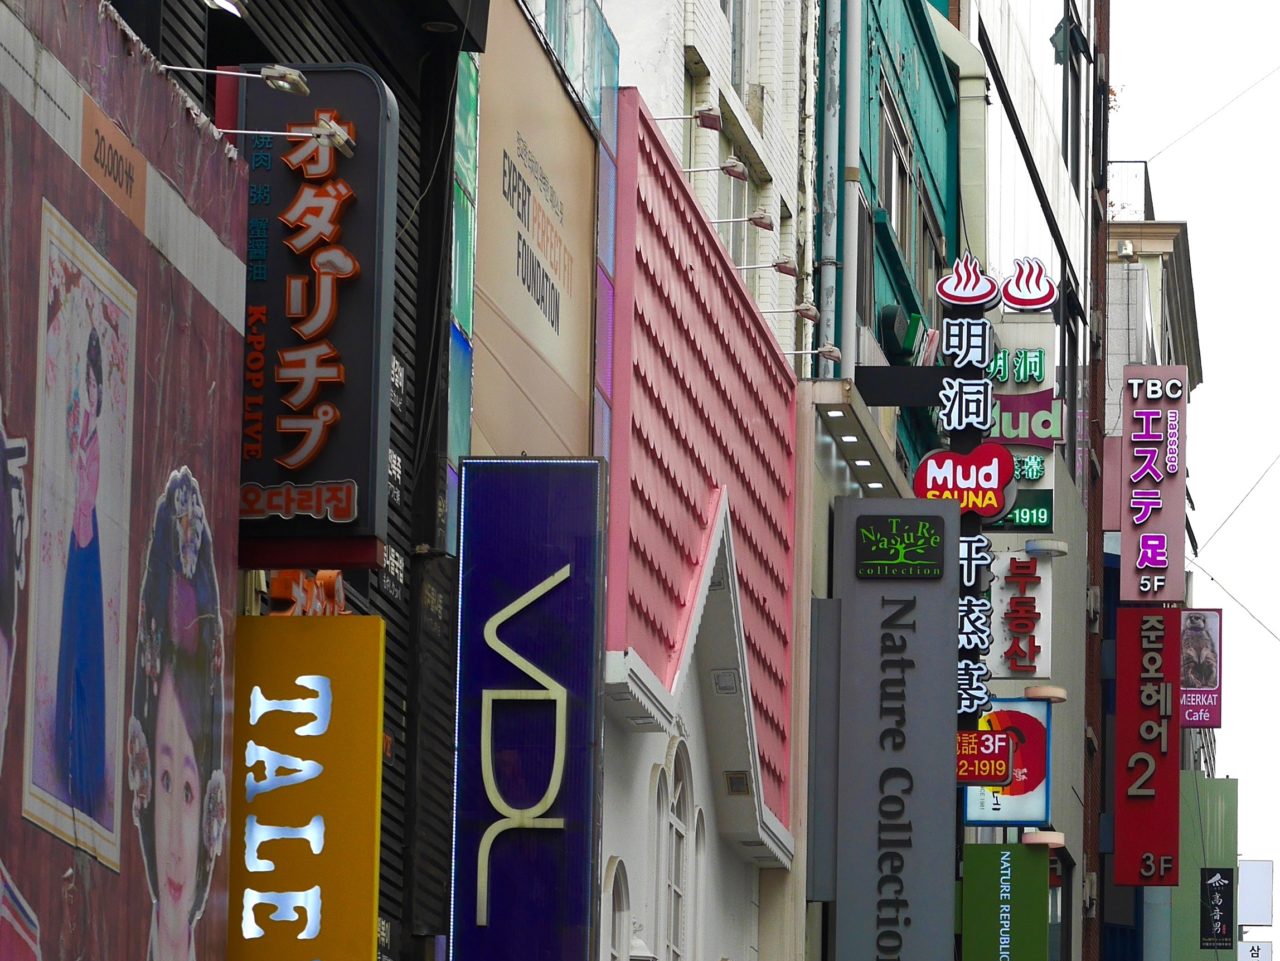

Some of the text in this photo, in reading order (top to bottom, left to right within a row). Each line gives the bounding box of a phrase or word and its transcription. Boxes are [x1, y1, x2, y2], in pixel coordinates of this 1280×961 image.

[502, 148, 532, 233] EXPERT
[531, 195, 563, 280] PERFECT
[562, 241, 574, 298] FIT
[516, 230, 561, 336] FOUNDATION
[243, 305, 267, 460] K-POP LIVE
[938, 317, 996, 431] 明洞
[1127, 379, 1184, 400] TBC
[1167, 410, 1180, 474] massage
[926, 457, 998, 489] Mud
[859, 565, 940, 575] collection
[1140, 575, 1166, 593] 5F
[1003, 556, 1042, 673] 부동산
[877, 595, 917, 753] Nature
[1126, 615, 1173, 797] 준오헤어 2
[1185, 709, 1211, 721] Café
[979, 734, 1007, 754] 3F
[1000, 851, 1011, 903] NATURE
[1140, 852, 1174, 877] 3F
